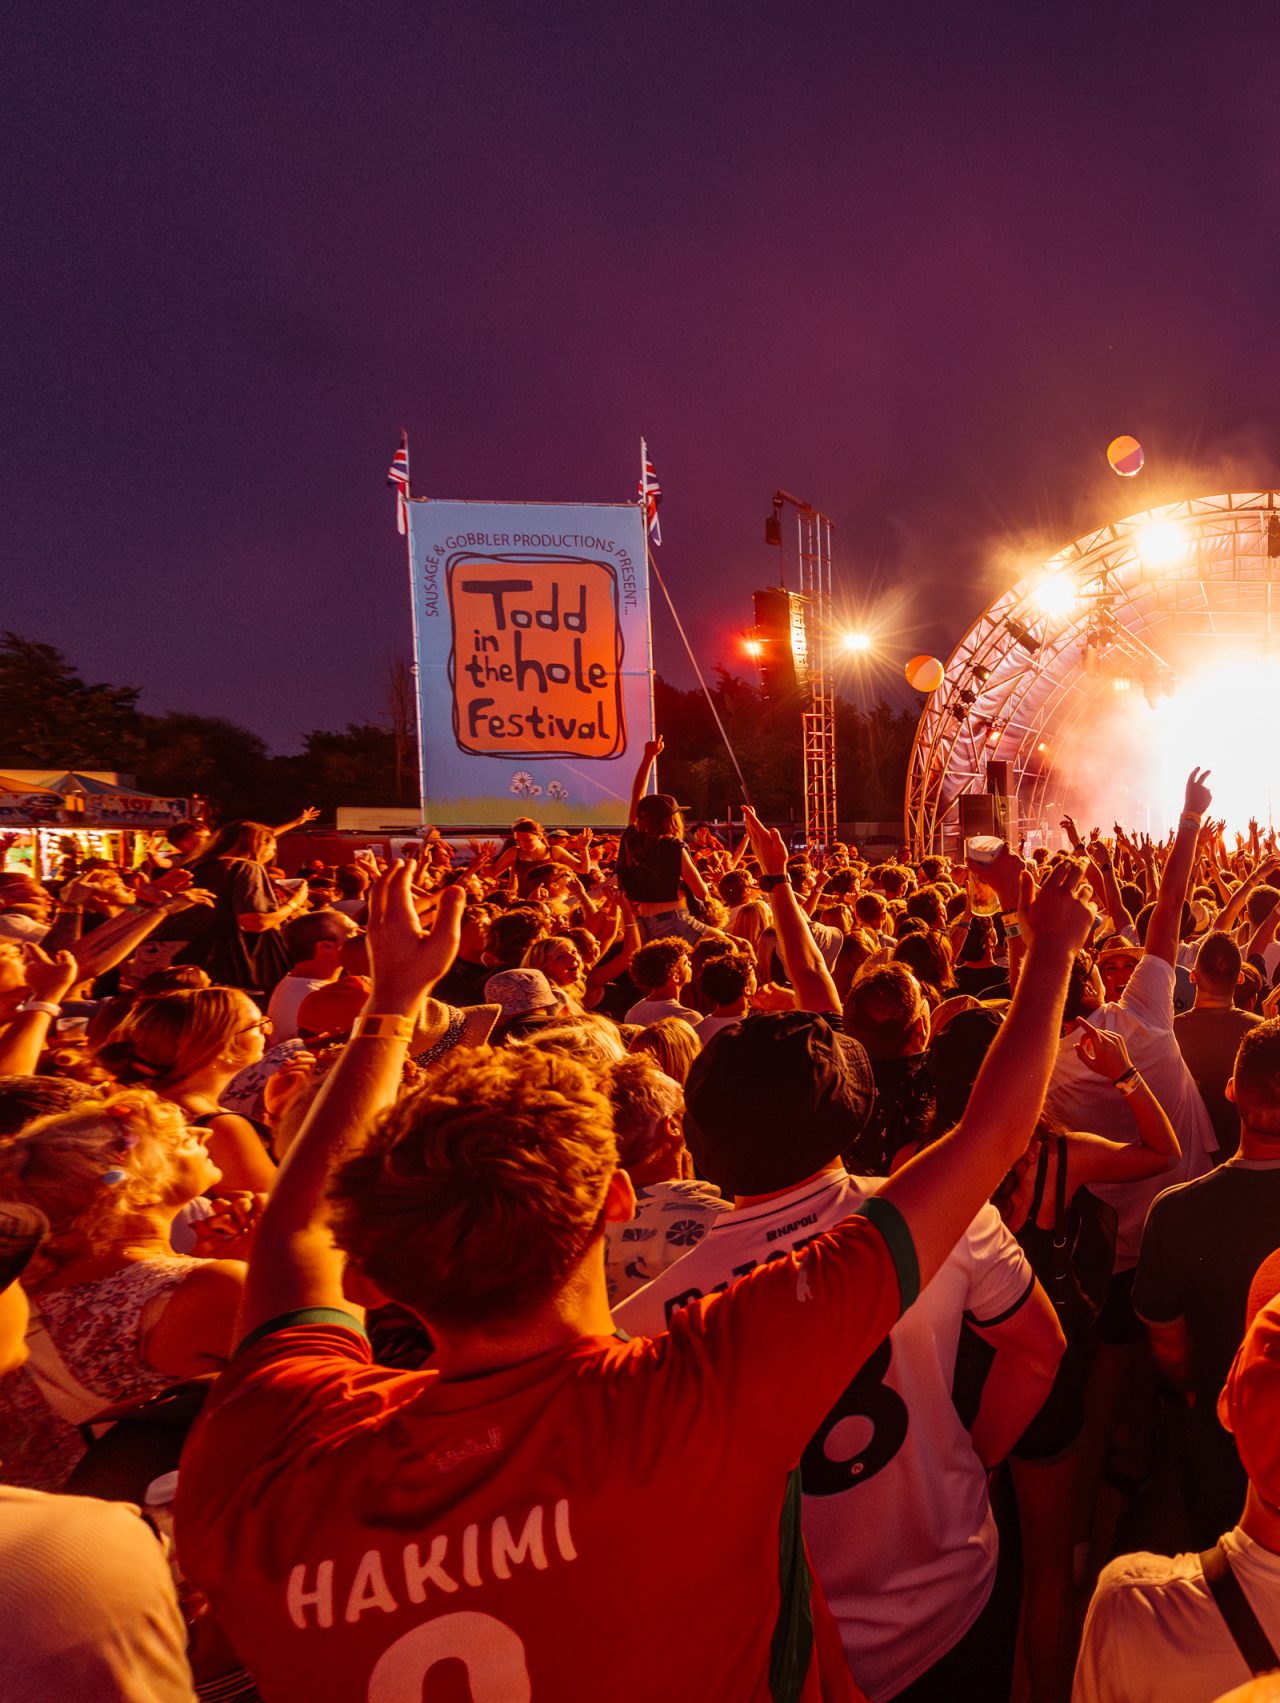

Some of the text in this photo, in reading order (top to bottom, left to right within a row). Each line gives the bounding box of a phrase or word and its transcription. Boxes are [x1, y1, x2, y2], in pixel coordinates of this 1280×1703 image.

[425, 533, 637, 617] SAUSAGE & GOBBLER PRODUCTIONS PRESENT...
[462, 580, 587, 634] Todd
[465, 630, 608, 693] the hole
[474, 630, 499, 652] in
[468, 698, 610, 740] Festival
[777, 1213, 818, 1237] NAPOLI
[287, 1499, 577, 1629] HAKIMI
